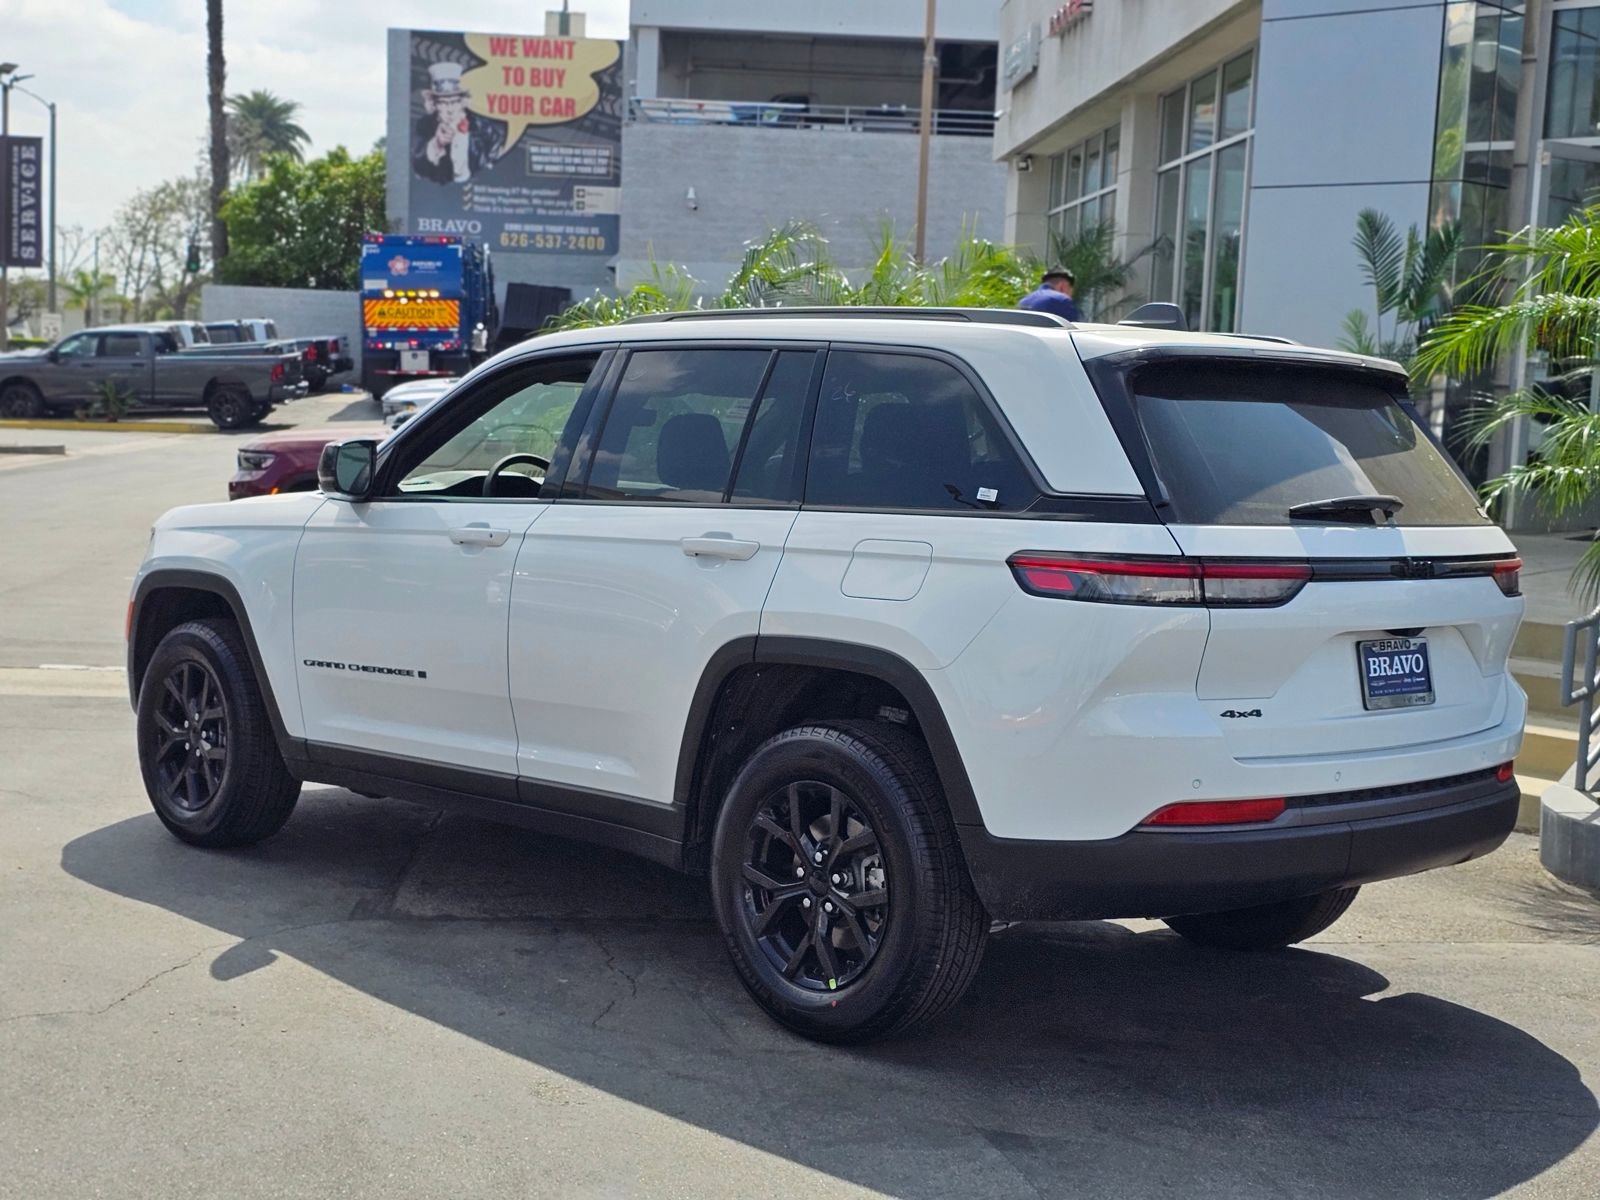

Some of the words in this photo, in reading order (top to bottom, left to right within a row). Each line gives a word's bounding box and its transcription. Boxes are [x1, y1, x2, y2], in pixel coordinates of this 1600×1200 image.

[489, 37, 519, 57] WE
[522, 38, 576, 60] WANT
[502, 66, 526, 87] TO
[530, 68, 566, 88] BUY
[487, 94, 535, 116] YOUR
[540, 97, 576, 117] CAR
[417, 218, 482, 234] BRAVO
[500, 232, 606, 250] 626-537-2400
[387, 307, 435, 319] CAUTION
[1379, 640, 1411, 651] BRAVO
[303, 659, 346, 670] GRAND
[348, 664, 416, 678] CHEROKEE
[1367, 654, 1424, 677] BRAVO
[1220, 709, 1263, 719] 4x4
